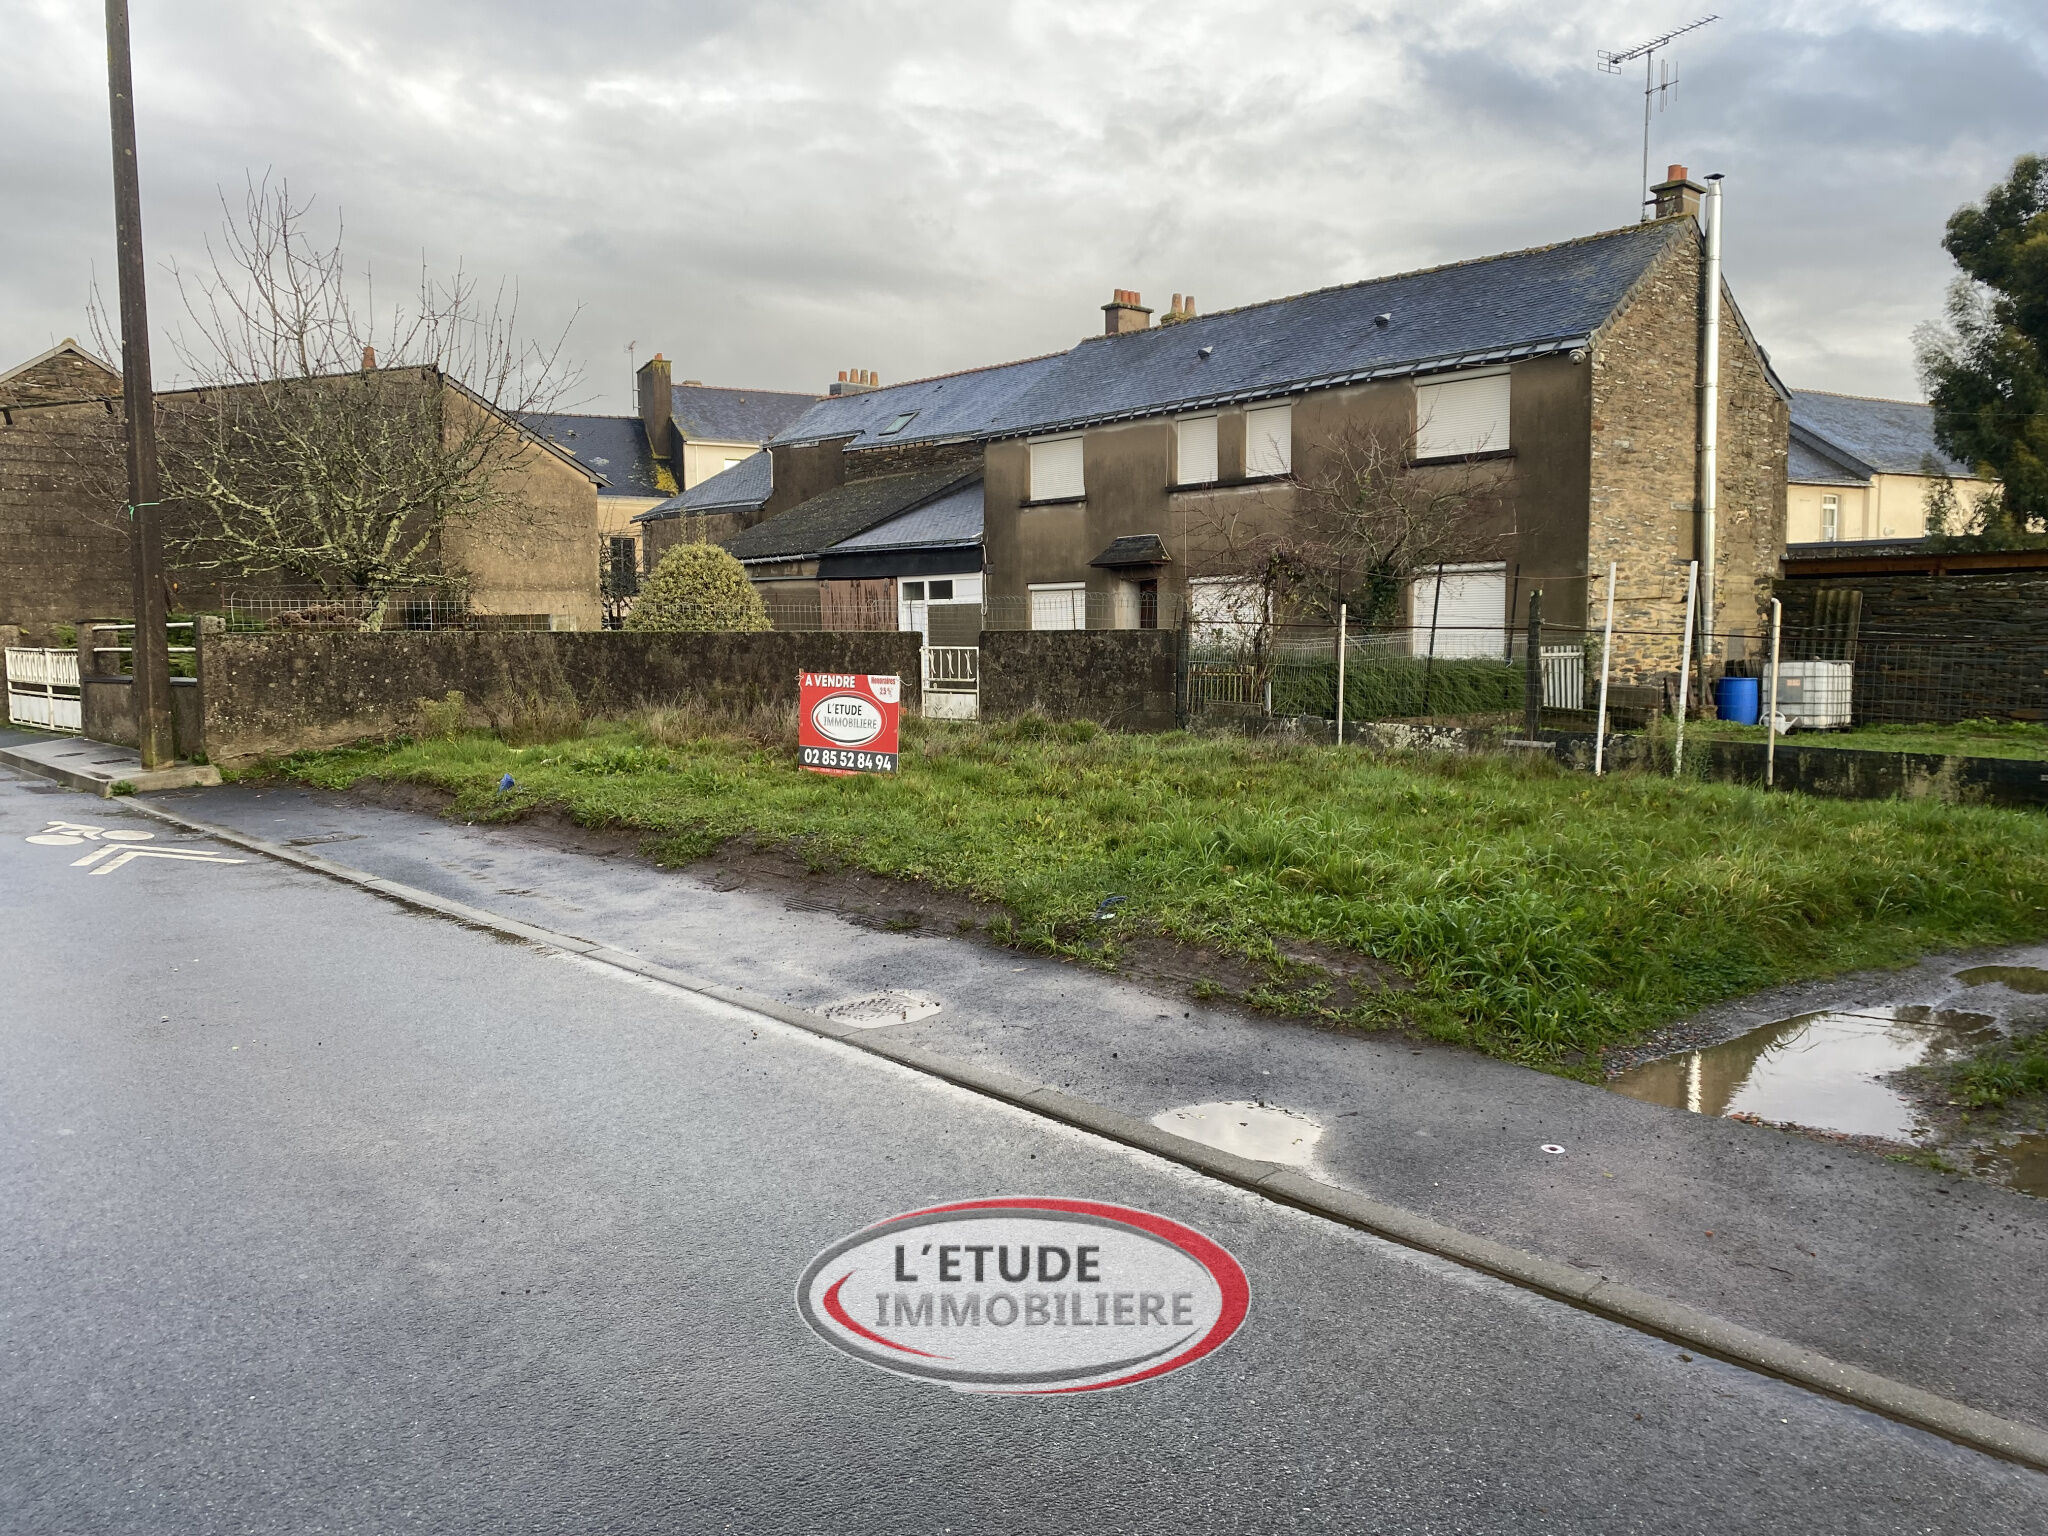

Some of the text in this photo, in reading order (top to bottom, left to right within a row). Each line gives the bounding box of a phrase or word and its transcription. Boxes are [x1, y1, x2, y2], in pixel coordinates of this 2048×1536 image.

[805, 674, 856, 689] A VENDRE
[827, 703, 862, 716] L'ETUDE
[823, 716, 877, 729] IMMOBILIERE
[804, 748, 892, 771] 02 85 52 84 94
